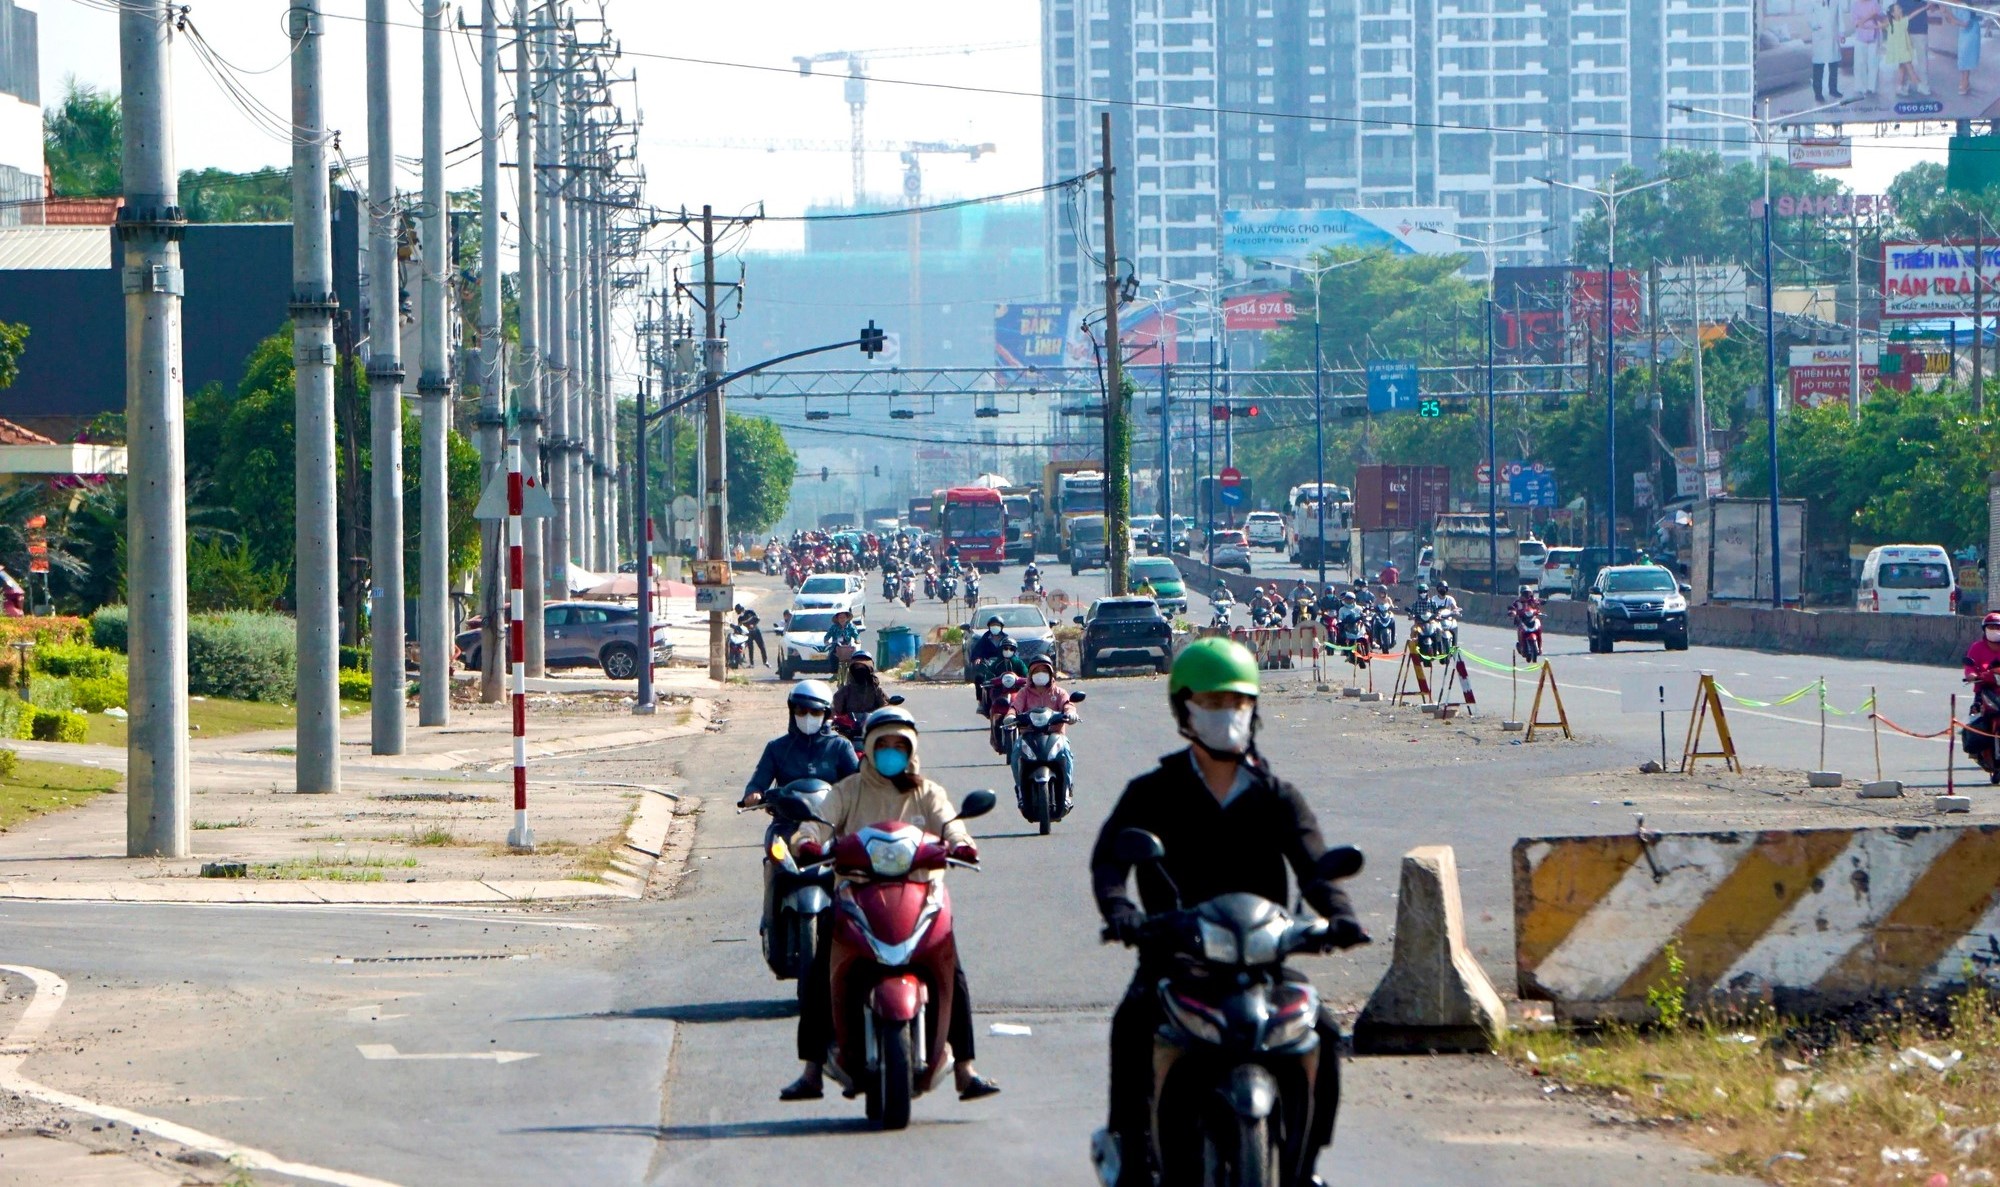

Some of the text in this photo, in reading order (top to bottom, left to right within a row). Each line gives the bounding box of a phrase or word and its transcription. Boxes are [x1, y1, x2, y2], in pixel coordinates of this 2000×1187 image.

[1297, 223, 1320, 235] CHO
[1259, 302, 1281, 315] 974
[1794, 368, 1824, 379] THIÊN
[1826, 367, 1842, 379] HÀ
[1421, 401, 1440, 418] 25
[1389, 481, 1407, 493] tex
